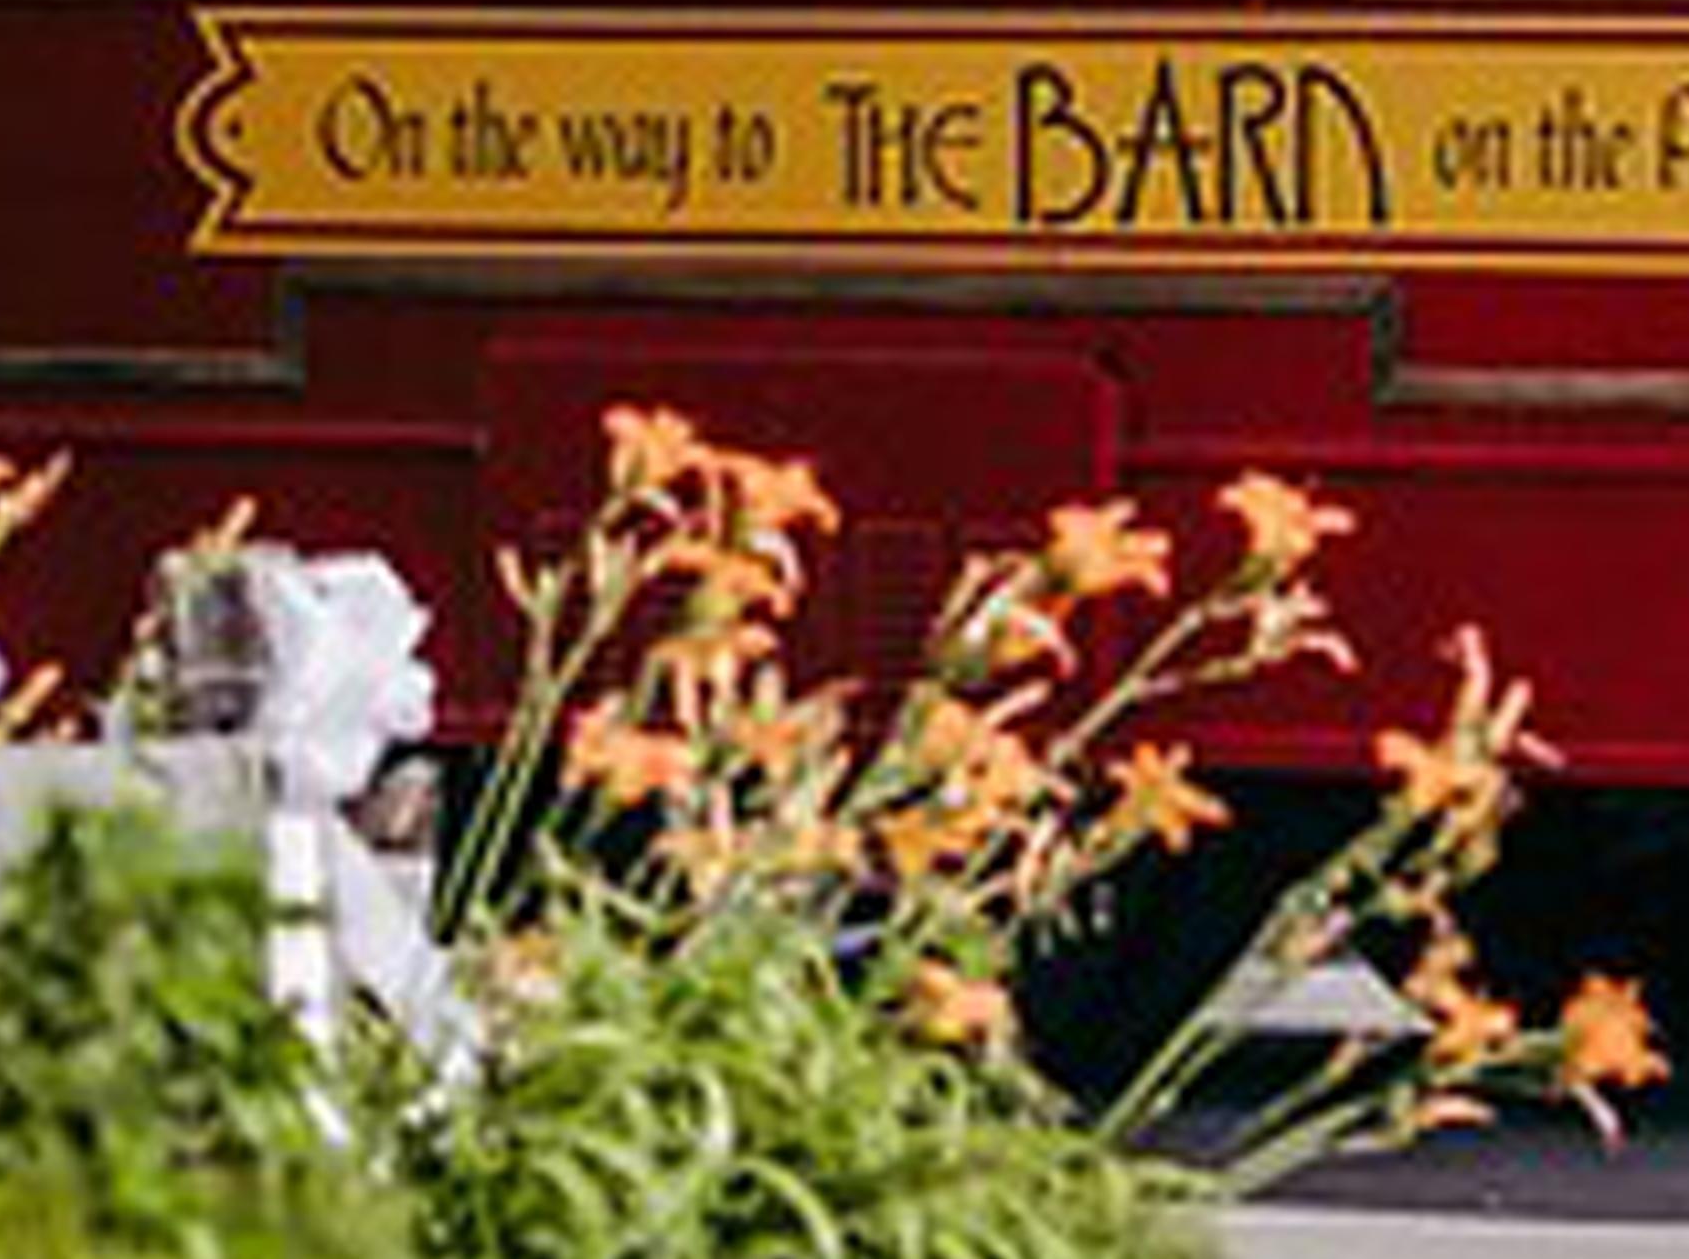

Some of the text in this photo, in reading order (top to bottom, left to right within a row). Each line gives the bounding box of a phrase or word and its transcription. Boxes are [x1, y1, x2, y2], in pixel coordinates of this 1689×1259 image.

[316, 71, 426, 182] On
[451, 78, 539, 181] the
[559, 110, 692, 212] way
[716, 102, 776, 183] to
[823, 80, 981, 212] THE
[1015, 54, 1389, 223] BARN
[1432, 116, 1513, 191] on
[1538, 85, 1633, 191] the
